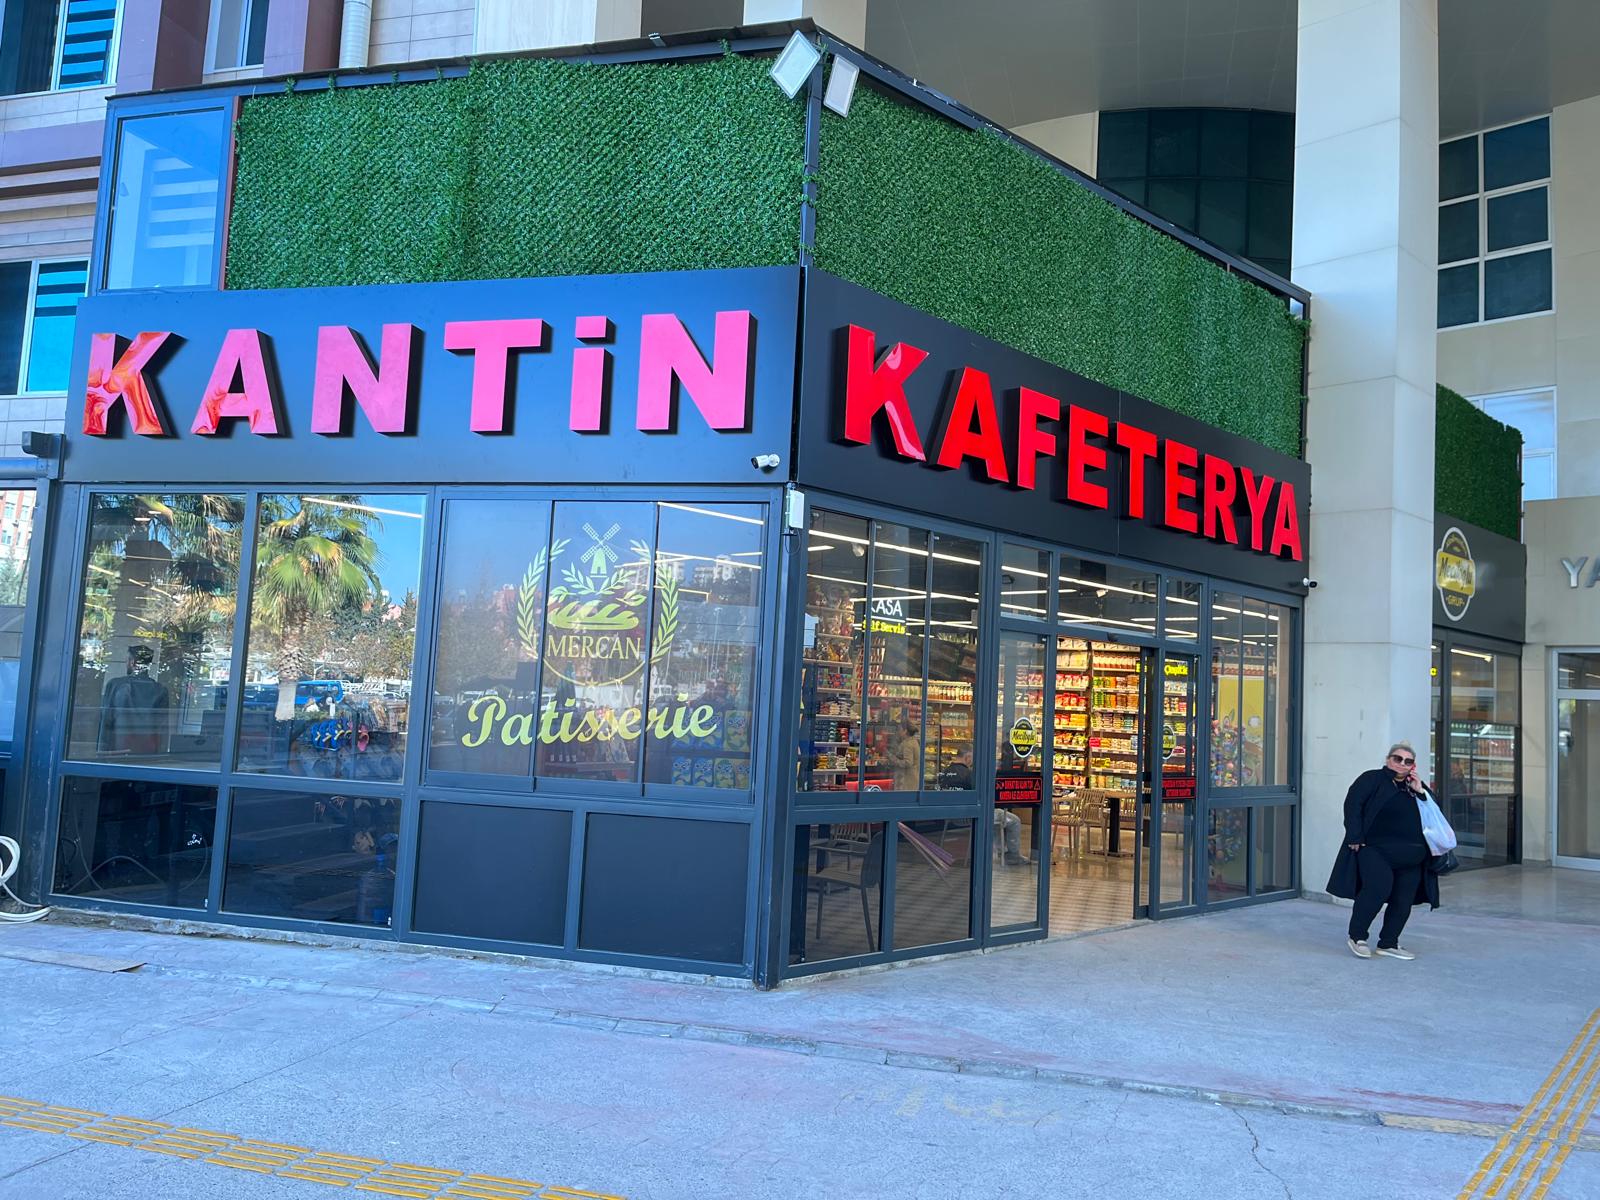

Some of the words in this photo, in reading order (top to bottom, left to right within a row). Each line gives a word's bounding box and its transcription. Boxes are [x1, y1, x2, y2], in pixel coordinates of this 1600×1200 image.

[841, 323, 1303, 562] KAFETERYA
[546, 635, 641, 659] MERCAN
[461, 693, 717, 748] Patisserie
